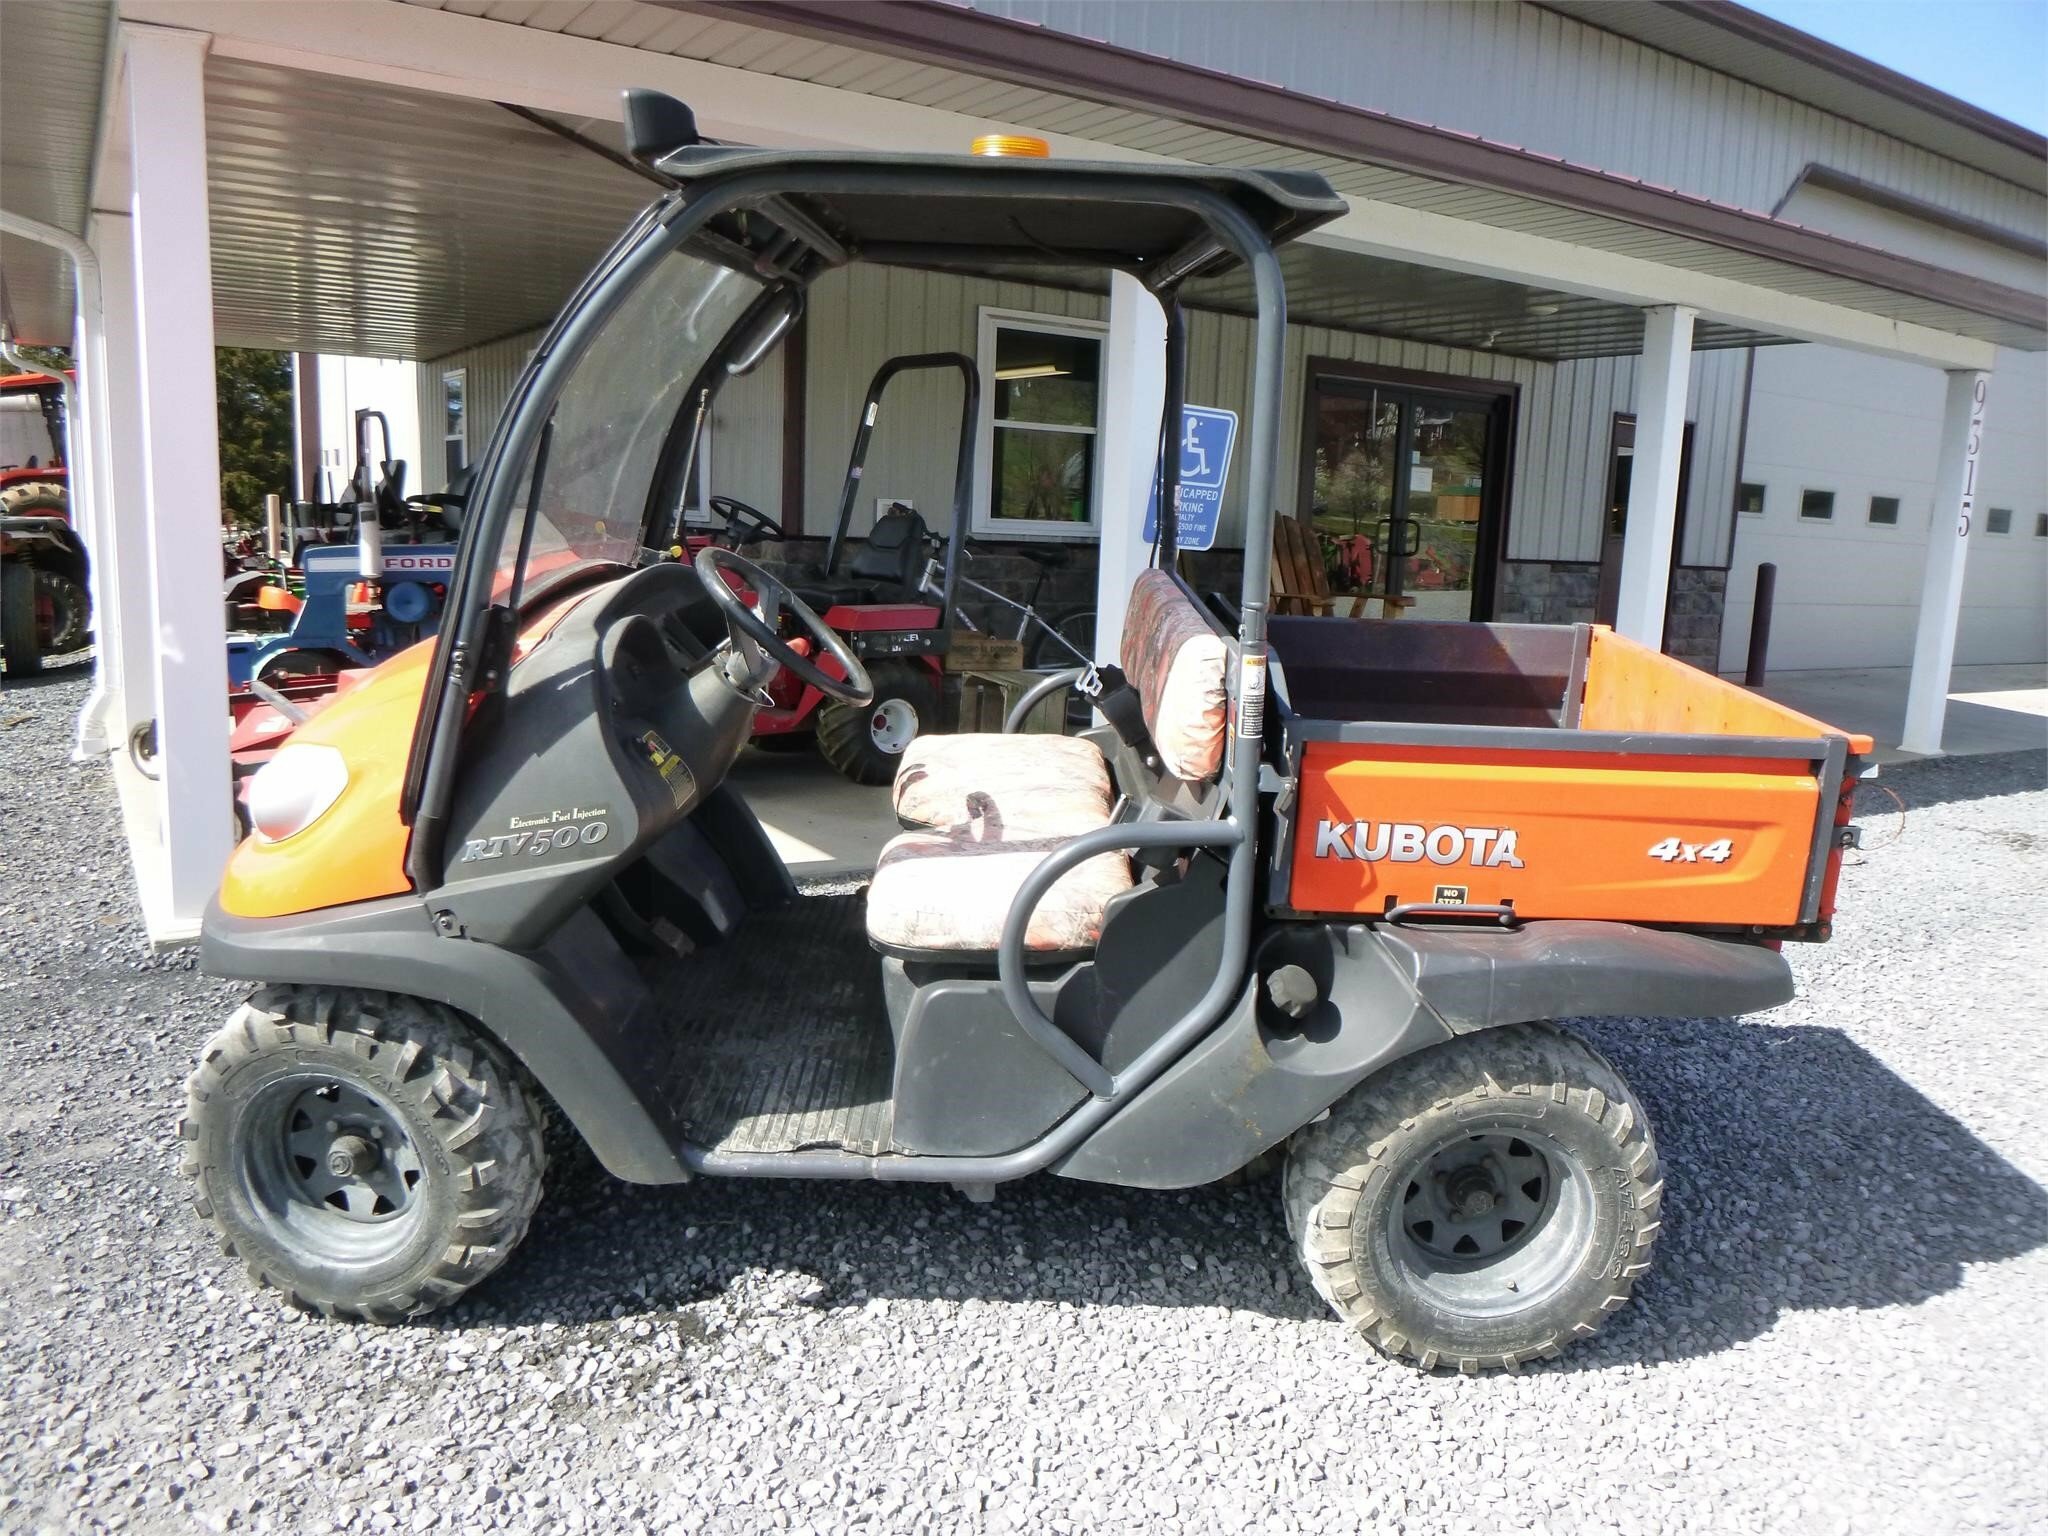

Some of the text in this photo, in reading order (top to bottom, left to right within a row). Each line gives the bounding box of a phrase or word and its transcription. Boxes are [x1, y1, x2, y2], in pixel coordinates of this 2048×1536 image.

[1958, 379, 1986, 537] 9515
[384, 558, 452, 568] FORD
[510, 808, 606, 829] Electronic Fuel Injection
[461, 821, 609, 863] RTV500
[1315, 819, 1525, 868] KUBOTA
[1647, 836, 1733, 863] 4x4
[1443, 889, 1459, 898] NO
